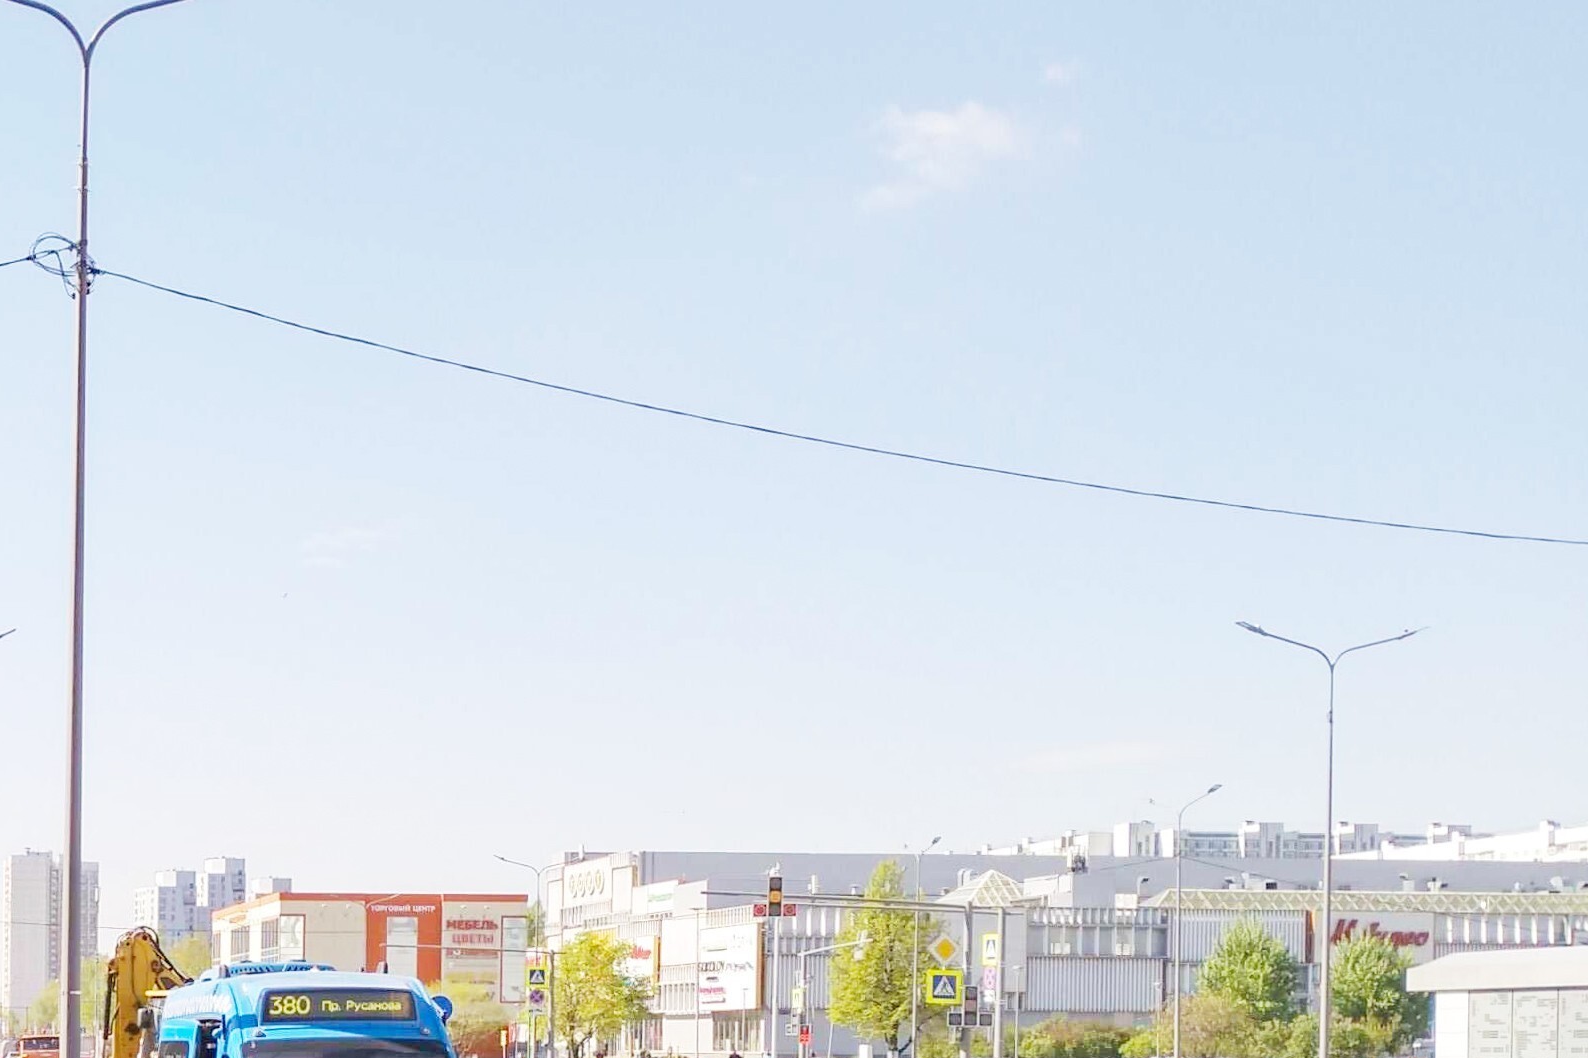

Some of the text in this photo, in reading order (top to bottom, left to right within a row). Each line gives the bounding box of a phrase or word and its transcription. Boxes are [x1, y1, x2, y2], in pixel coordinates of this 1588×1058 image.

[412, 904, 436, 913] ЦЕНТР
[445, 919, 499, 930] МЕБЕЛЬ
[269, 996, 402, 1014] 380 Пр. Русанова
